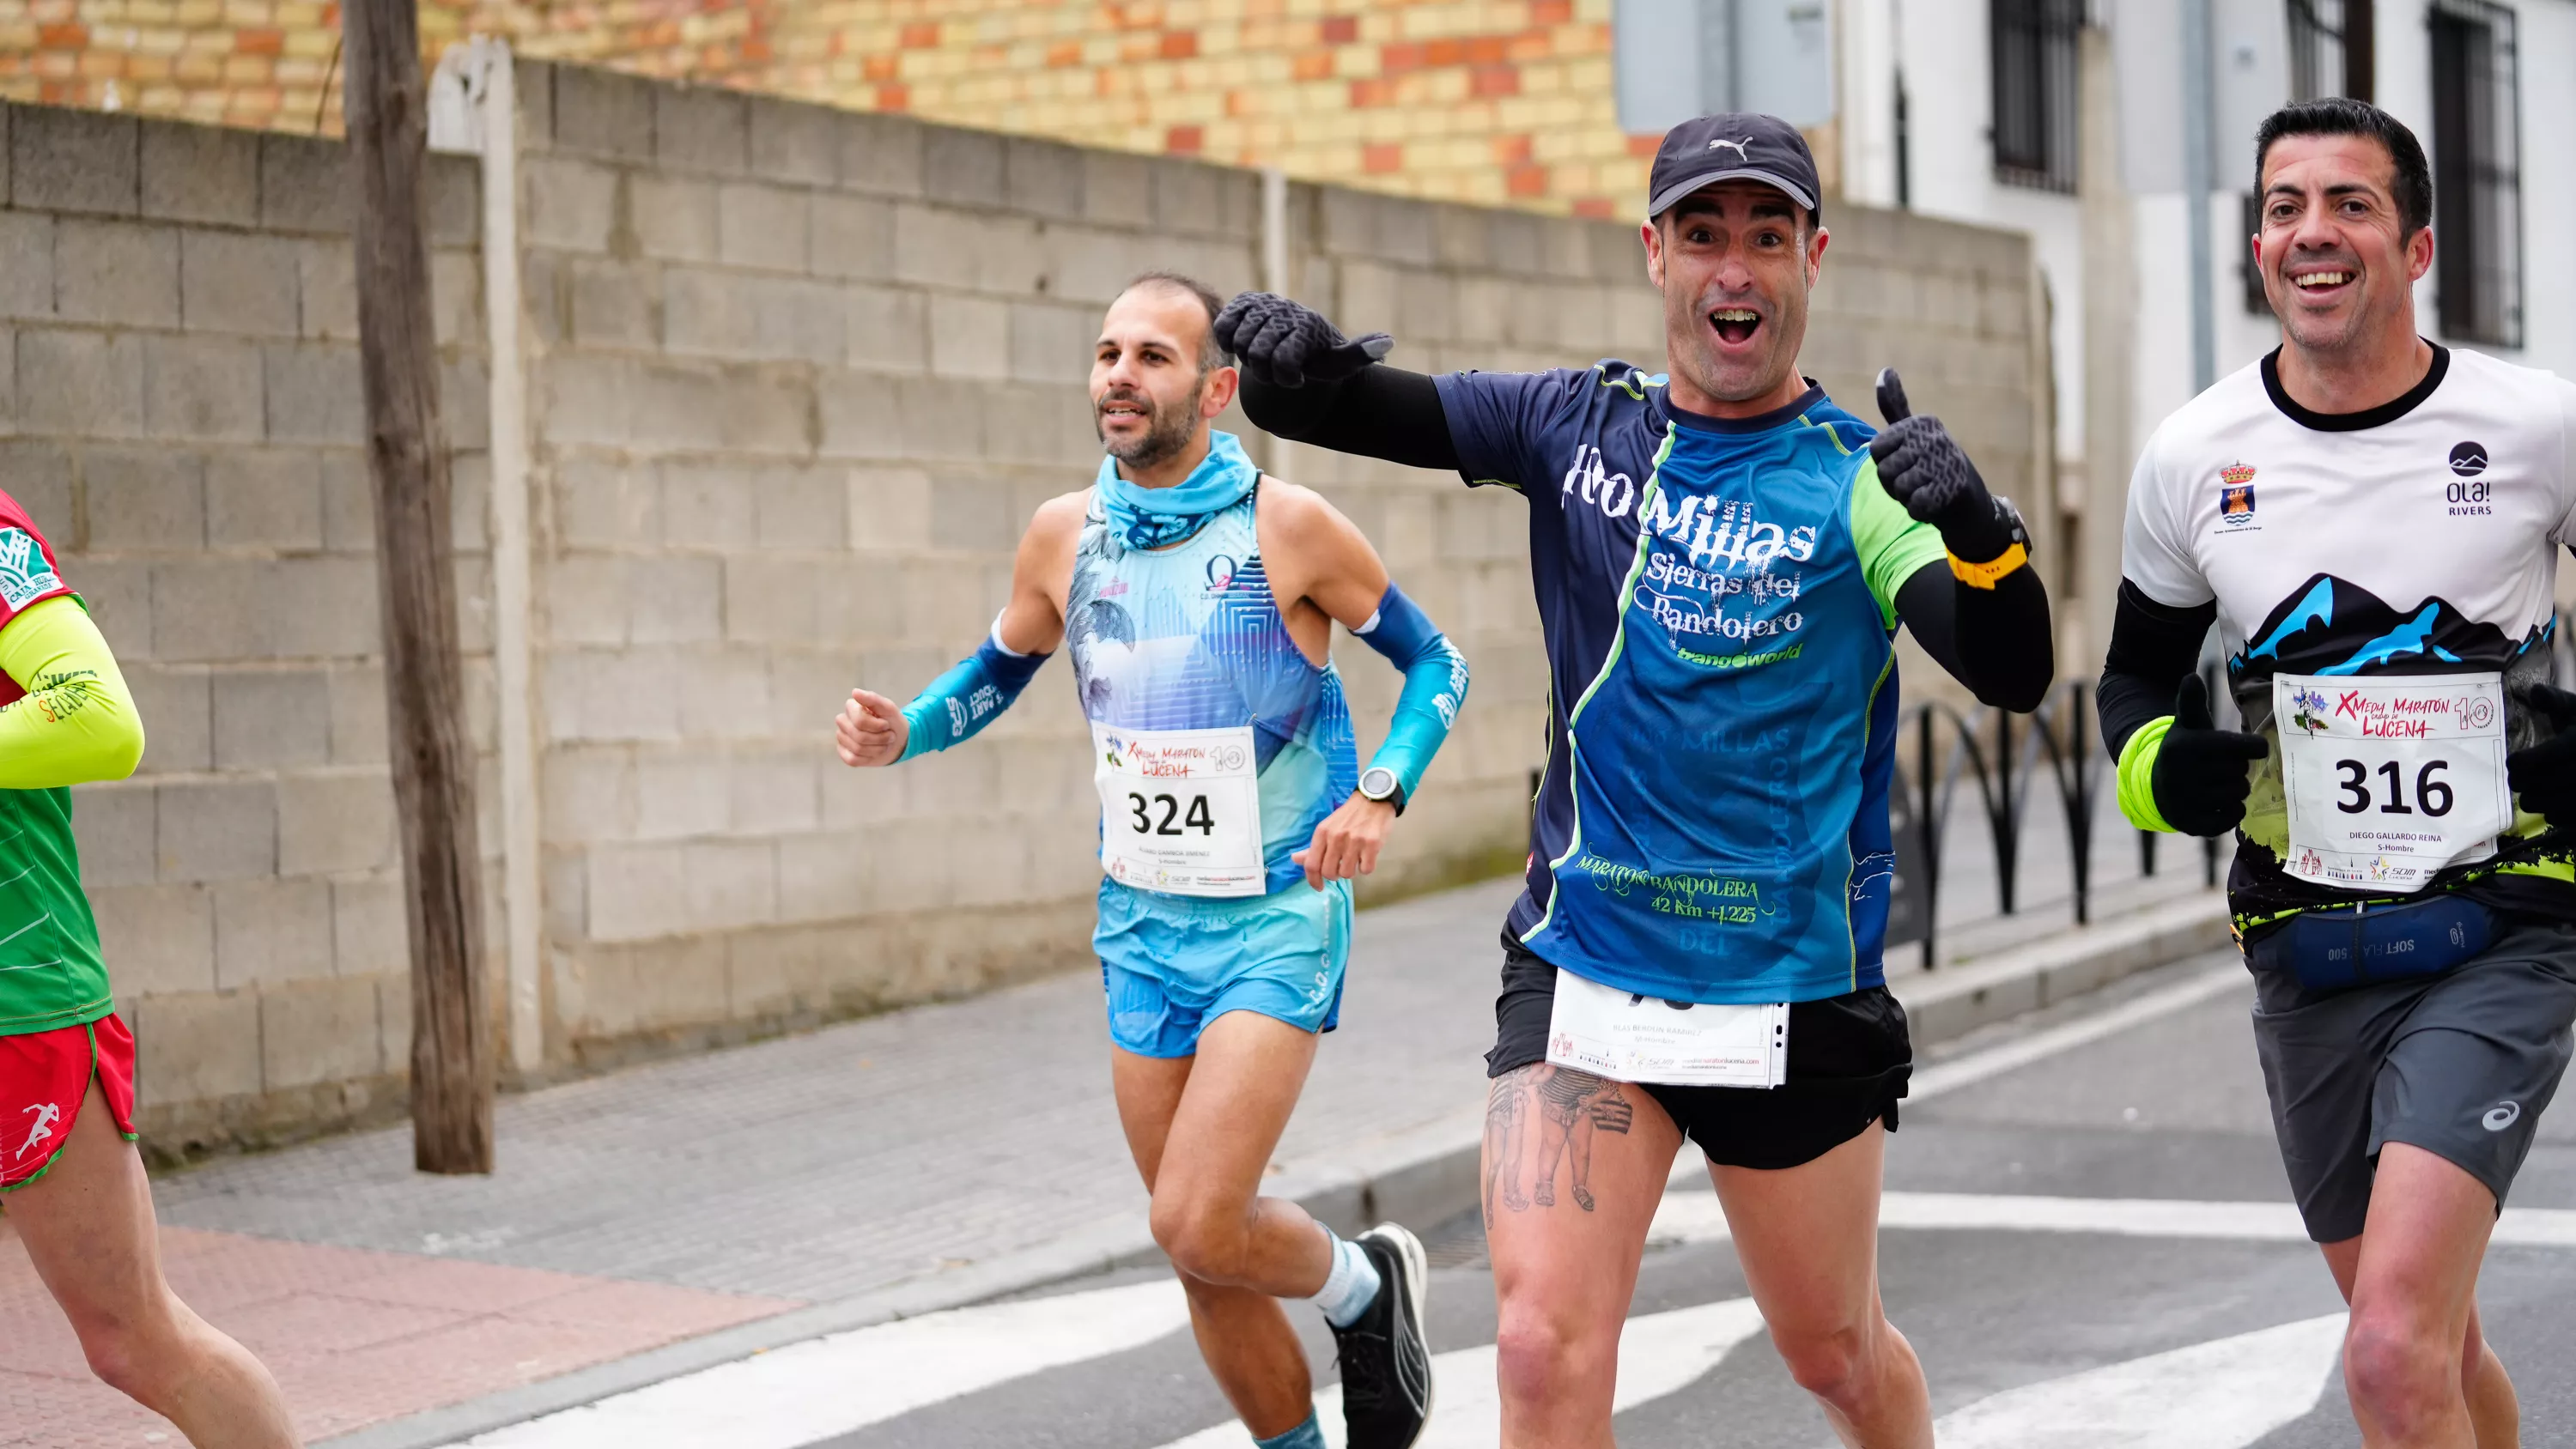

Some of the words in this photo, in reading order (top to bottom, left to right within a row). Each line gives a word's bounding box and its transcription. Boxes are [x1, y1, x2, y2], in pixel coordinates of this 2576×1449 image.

[2449, 506, 2492, 516] RIVERS
[1637, 486, 1816, 570] Millas
[1646, 552, 1743, 594] Sierras
[1747, 570, 1802, 605] del
[10, 585, 32, 603] CAJA
[1649, 596, 1804, 644] Bandolero
[1677, 643, 1803, 669] trangoworld
[2393, 698, 2450, 714] MARATÓN
[2363, 716, 2437, 738] LUCENA
[1142, 761, 1196, 779] LUCENA
[2336, 759, 2453, 817] 316
[1129, 791, 1214, 835] 324
[2376, 833, 2417, 841] GALLARDO
[2418, 834, 2442, 842] REINA
[2378, 844, 2415, 852] S-Hombre
[1650, 869, 1760, 903] BANDOLERA
[1651, 897, 1670, 912] 42
[1674, 899, 1703, 918] Km
[1707, 905, 1757, 925] +1.225
[2328, 948, 2348, 961] 500
[2385, 939, 2415, 955] SOFT
